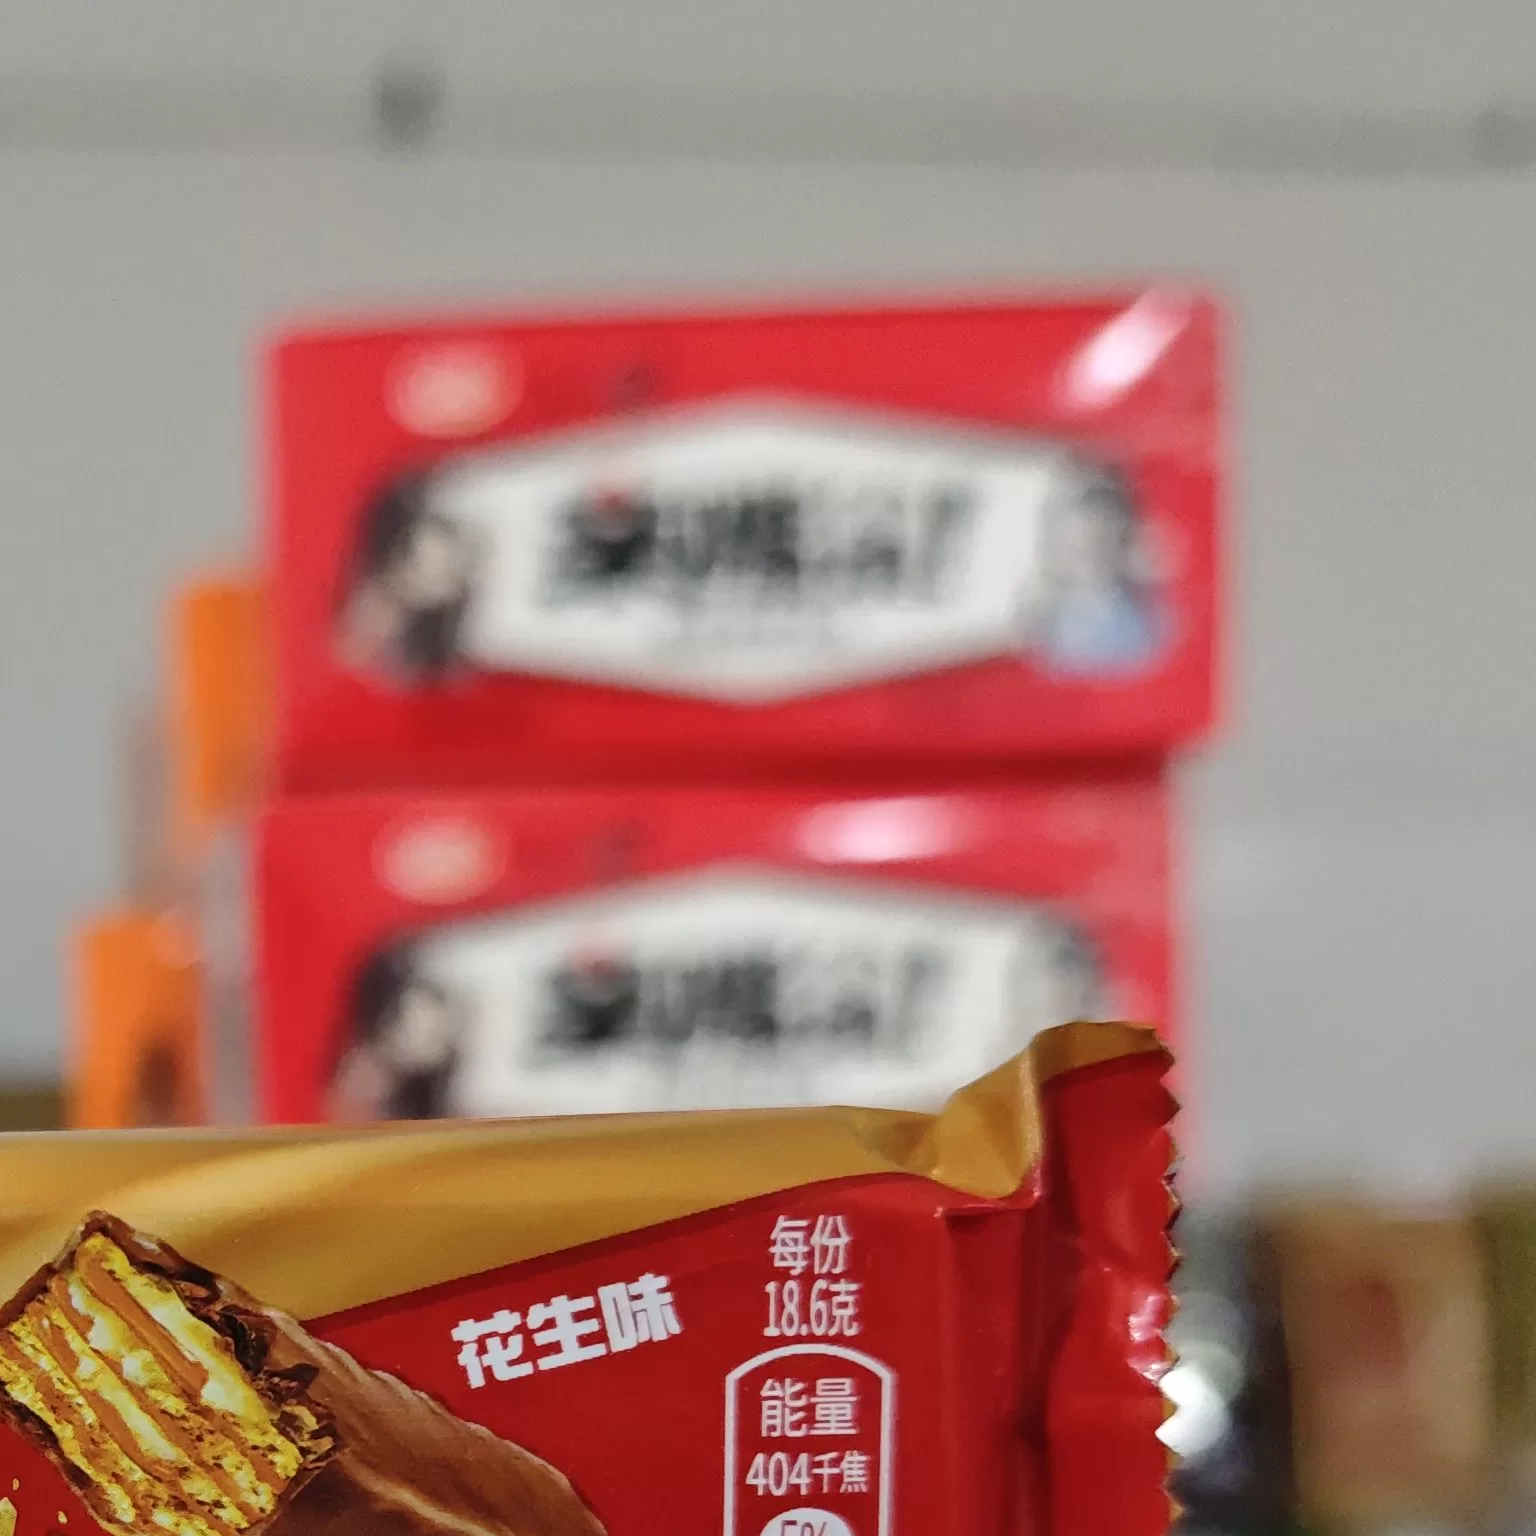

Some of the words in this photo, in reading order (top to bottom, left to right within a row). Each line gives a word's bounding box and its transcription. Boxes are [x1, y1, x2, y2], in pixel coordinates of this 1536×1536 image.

[768, 1214, 852, 1276] 每份
[451, 1272, 684, 1389] 花生味
[763, 1278, 862, 1338] 18.6克
[760, 1377, 858, 1438] 能量
[745, 1450, 870, 1497] 404千焦
